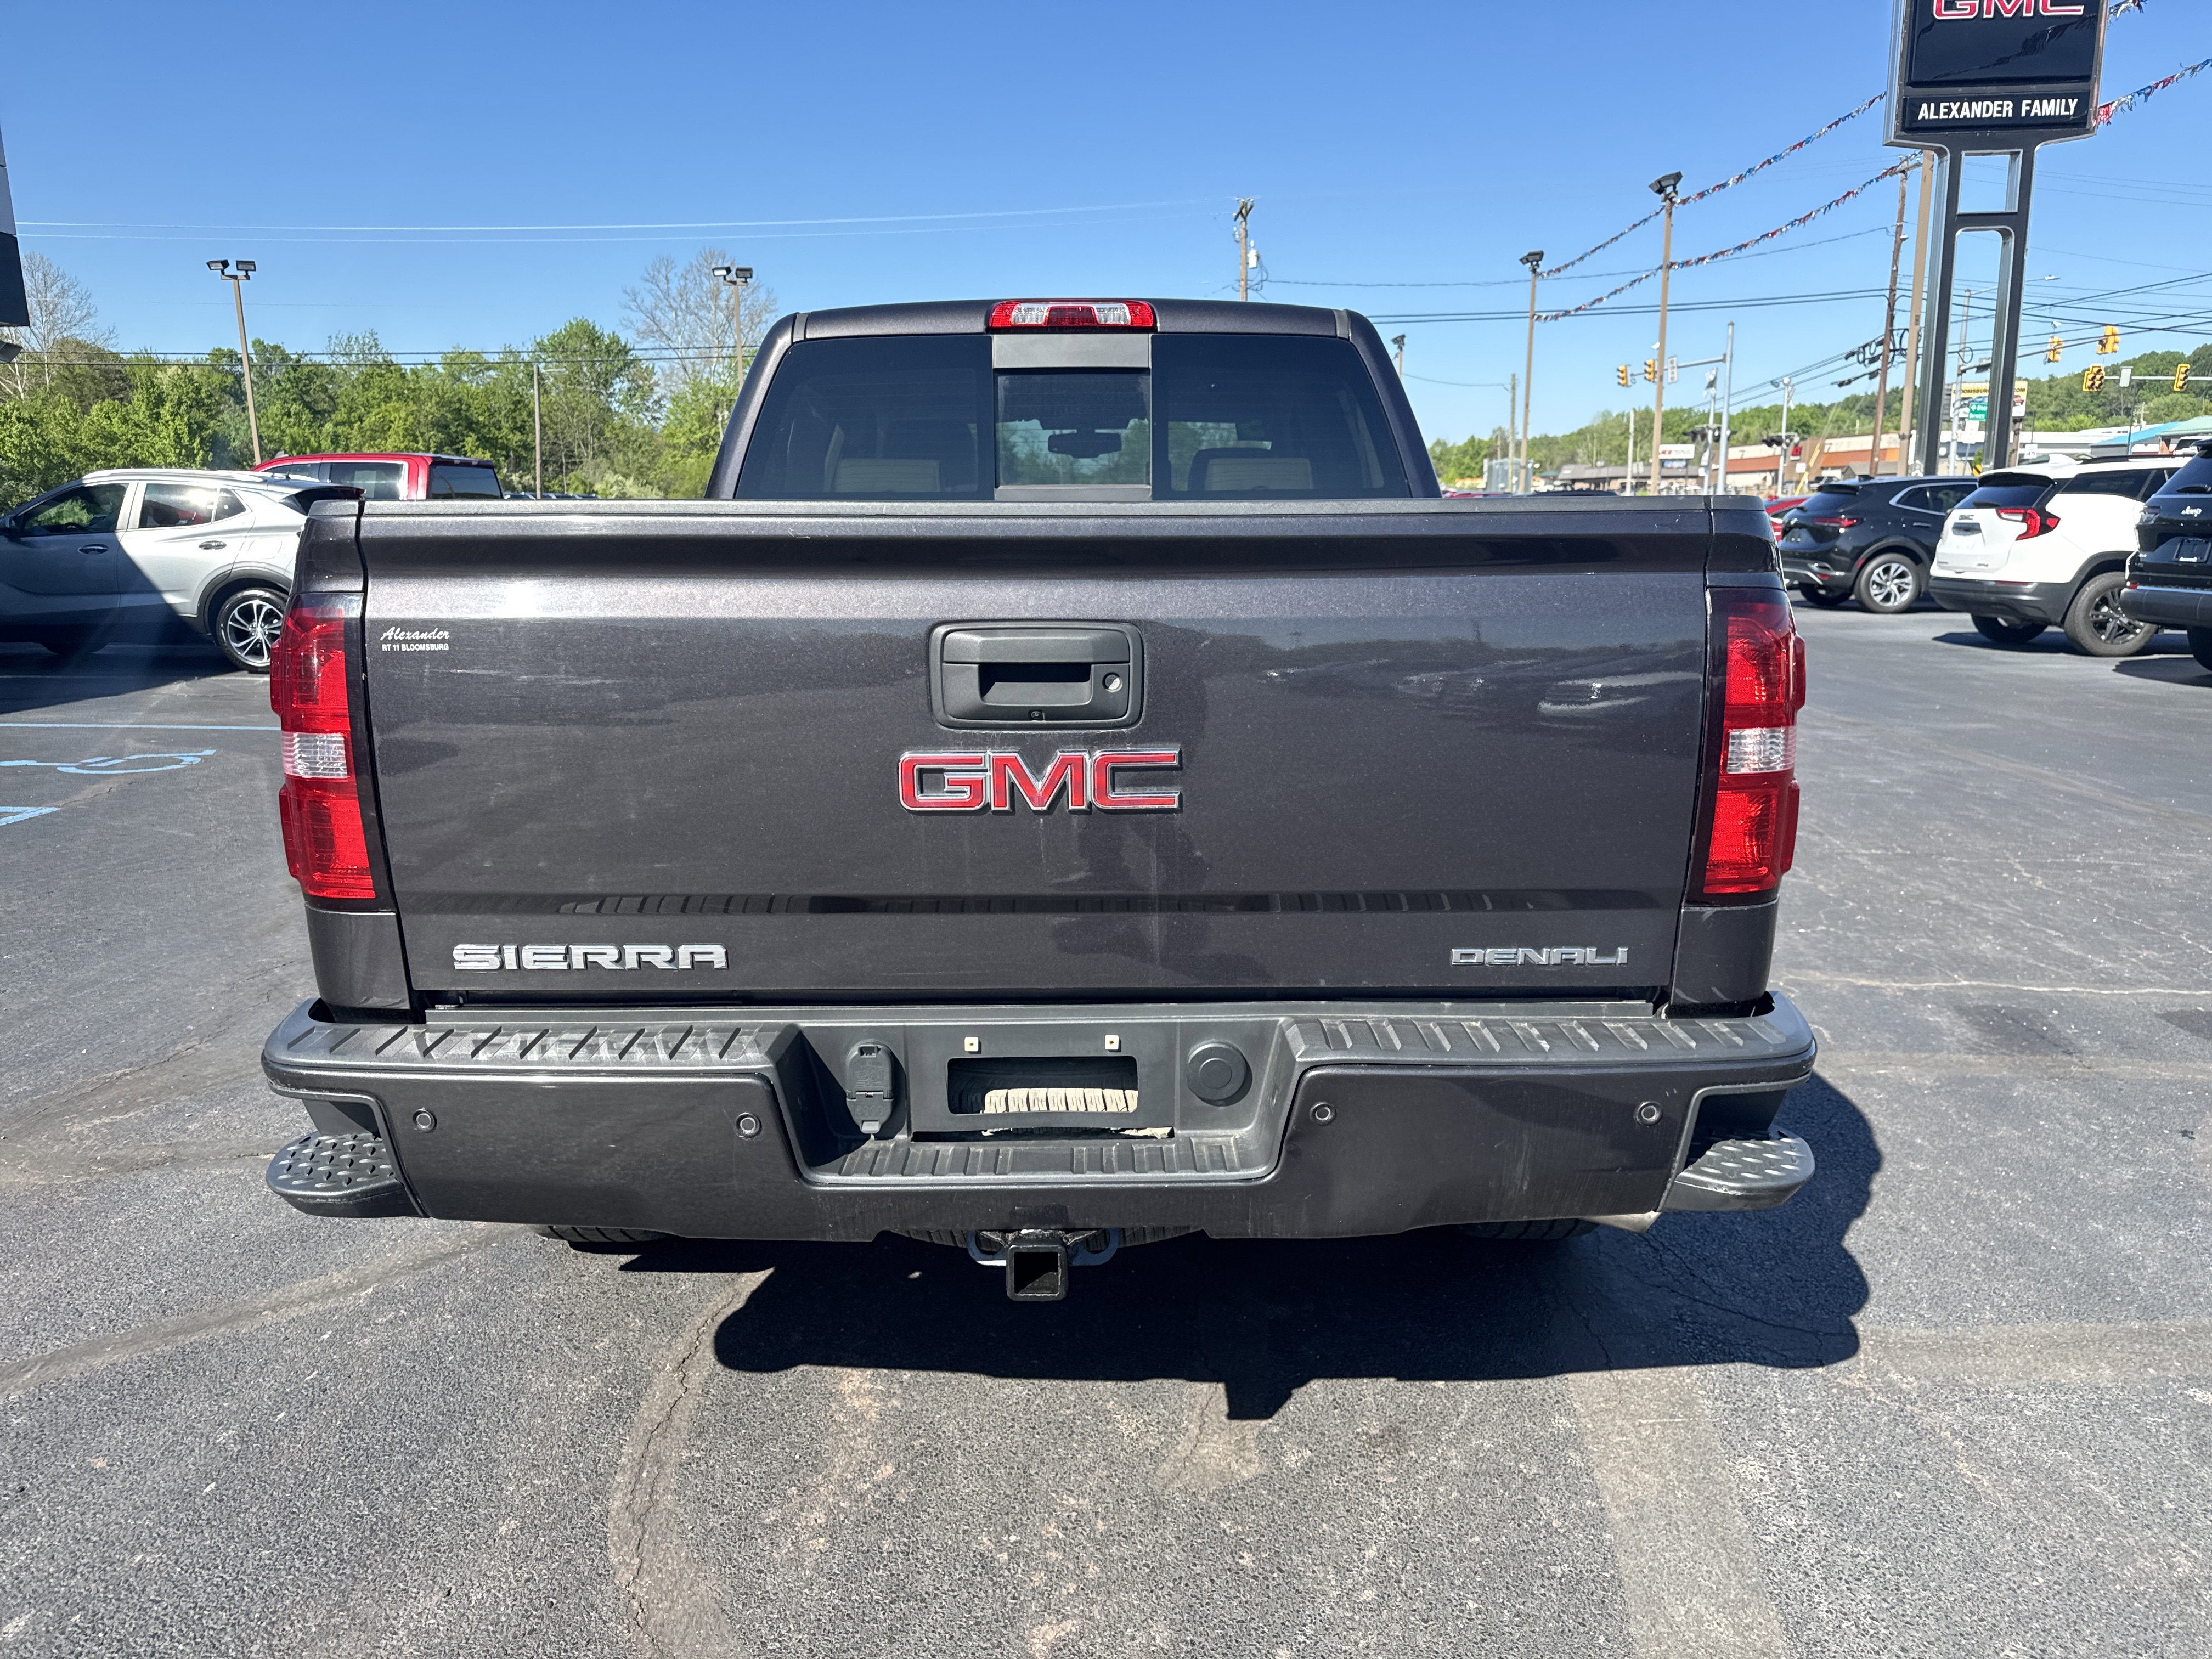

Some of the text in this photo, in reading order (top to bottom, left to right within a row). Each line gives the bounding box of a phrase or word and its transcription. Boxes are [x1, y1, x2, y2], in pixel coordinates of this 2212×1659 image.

[1933, 0, 2084, 19] GMC
[1918, 98, 2078, 120] ALEXANDER FAMILY
[380, 626, 450, 641] Alexander
[401, 643, 449, 651] BLOOMSBURG
[898, 748, 1181, 811] GMC
[453, 944, 729, 970] SIERRA
[1451, 946, 1628, 966] DENALI
